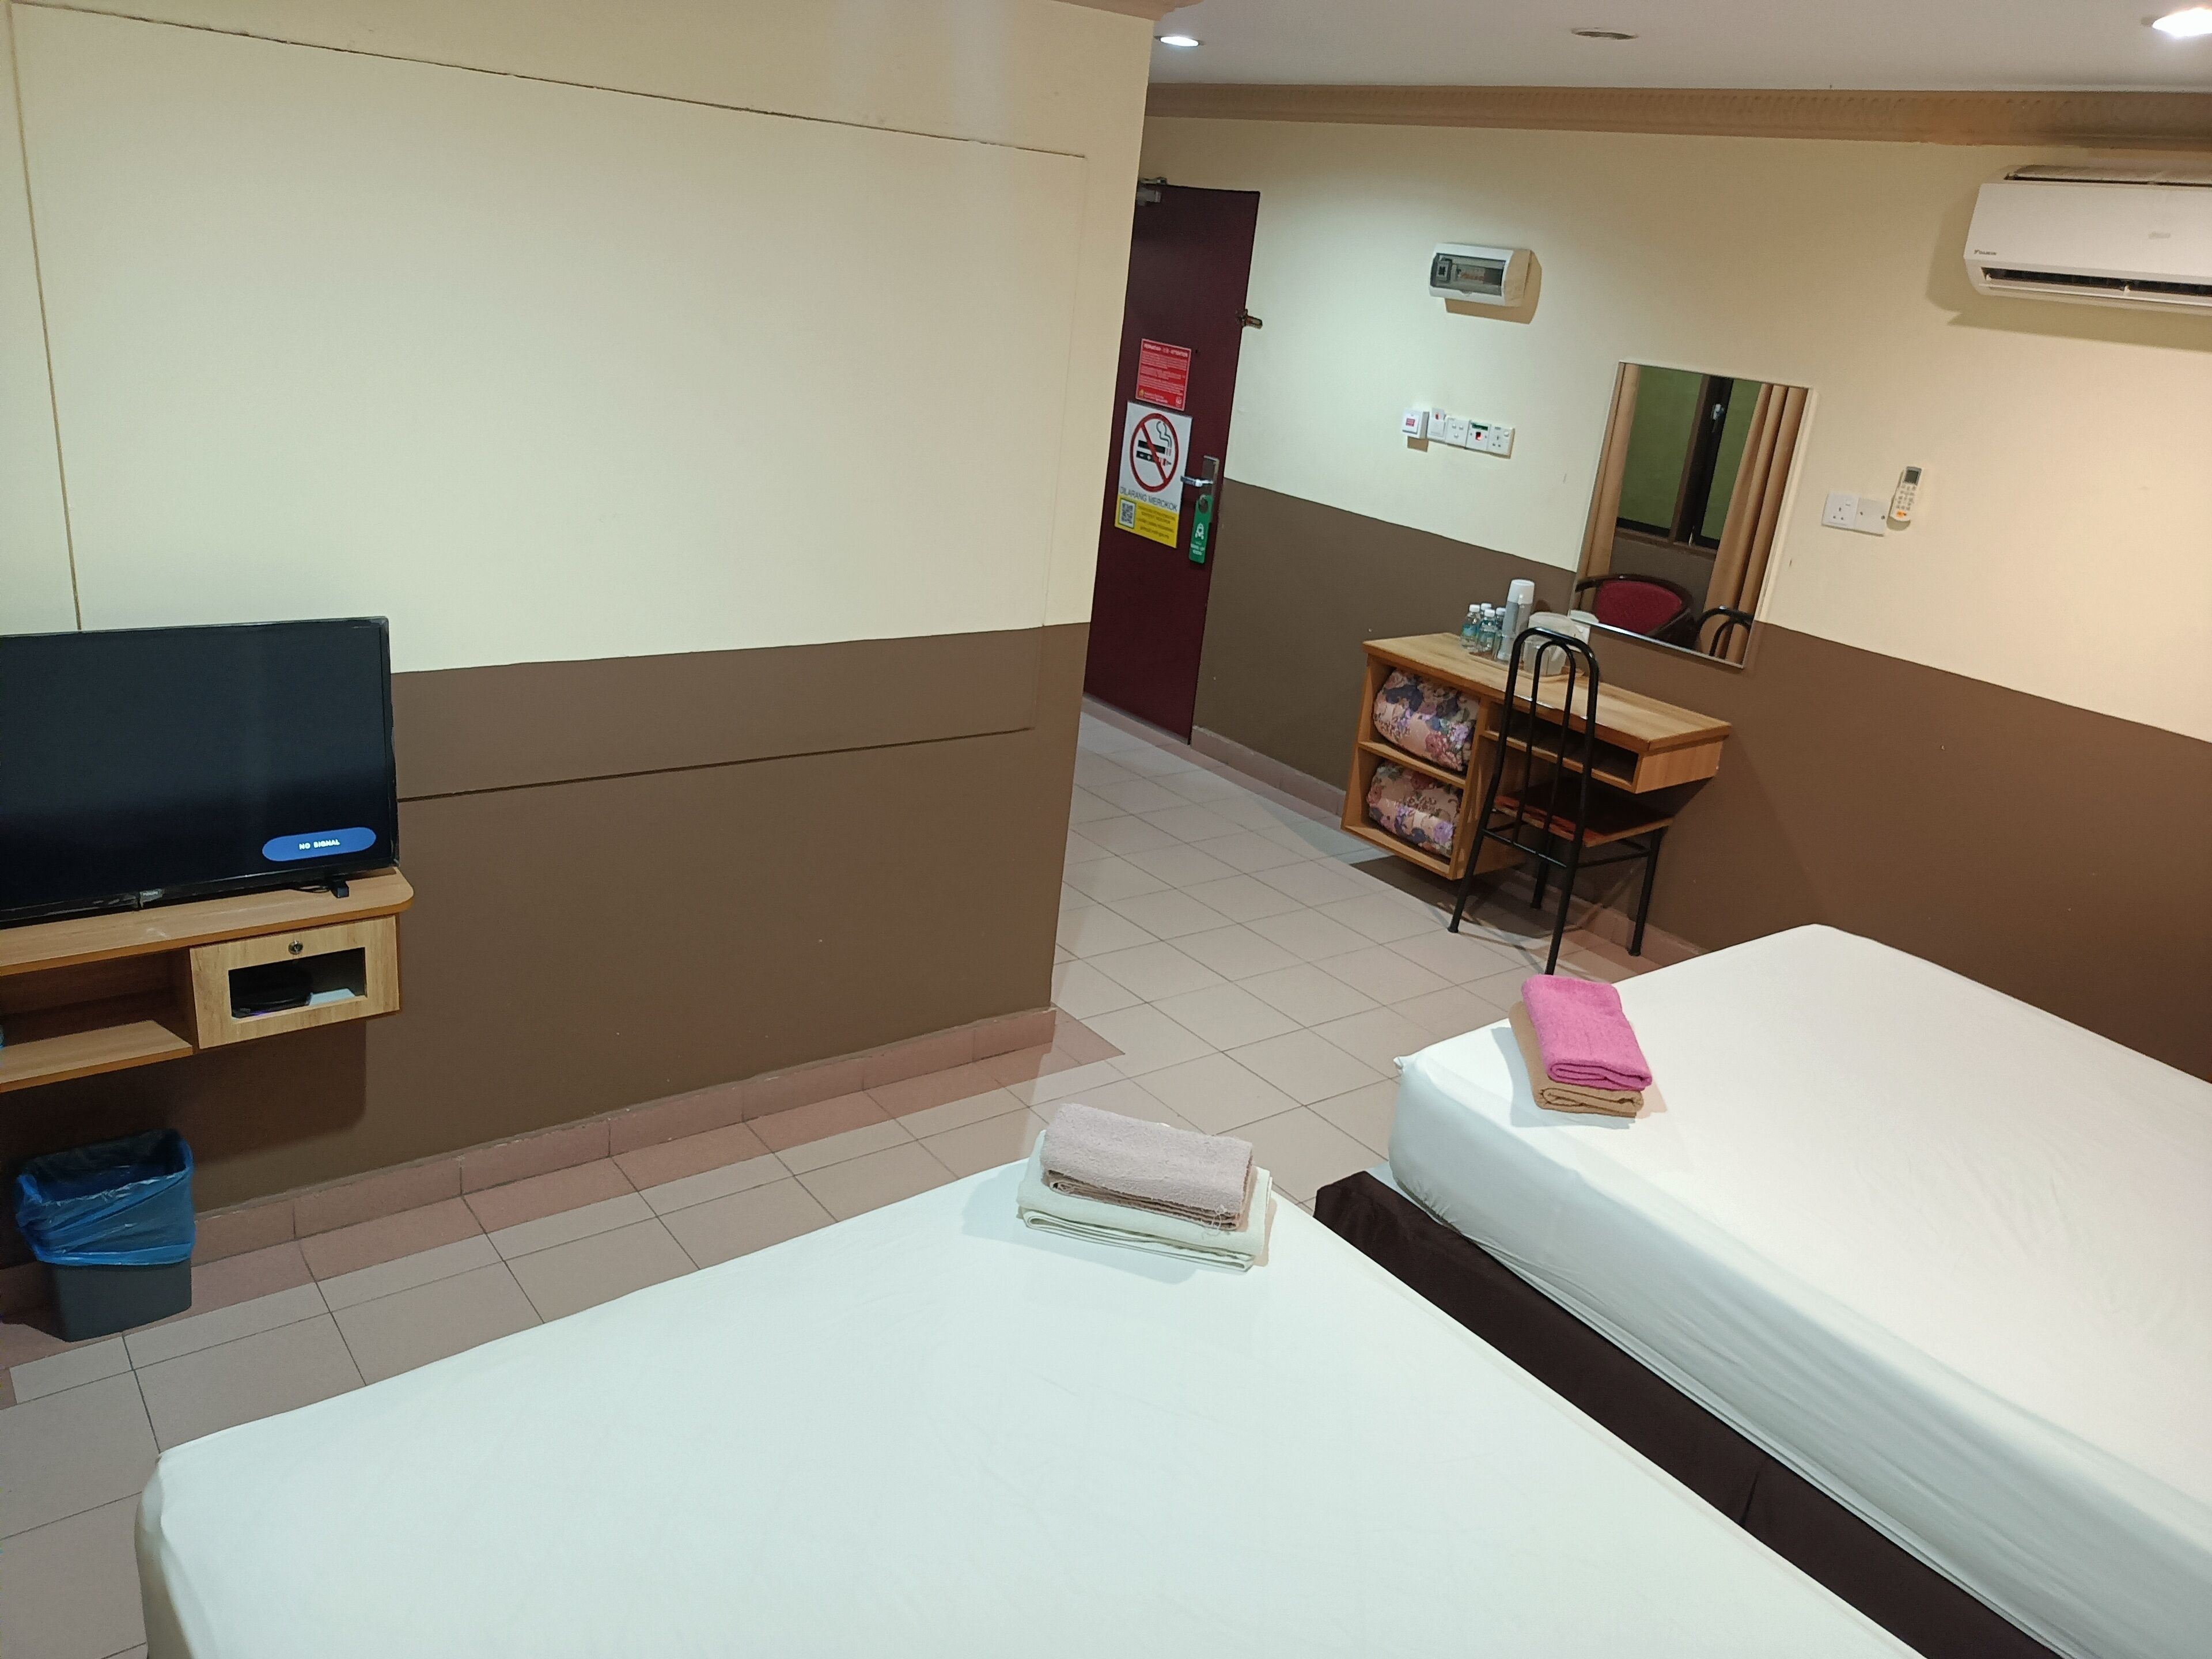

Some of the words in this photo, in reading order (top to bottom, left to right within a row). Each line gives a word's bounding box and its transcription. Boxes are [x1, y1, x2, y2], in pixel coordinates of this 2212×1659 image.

[1120, 486, 1146, 502] DILARANG
[1148, 496, 1177, 511] MEROKOK
[313, 839, 340, 848] SIGNAL
